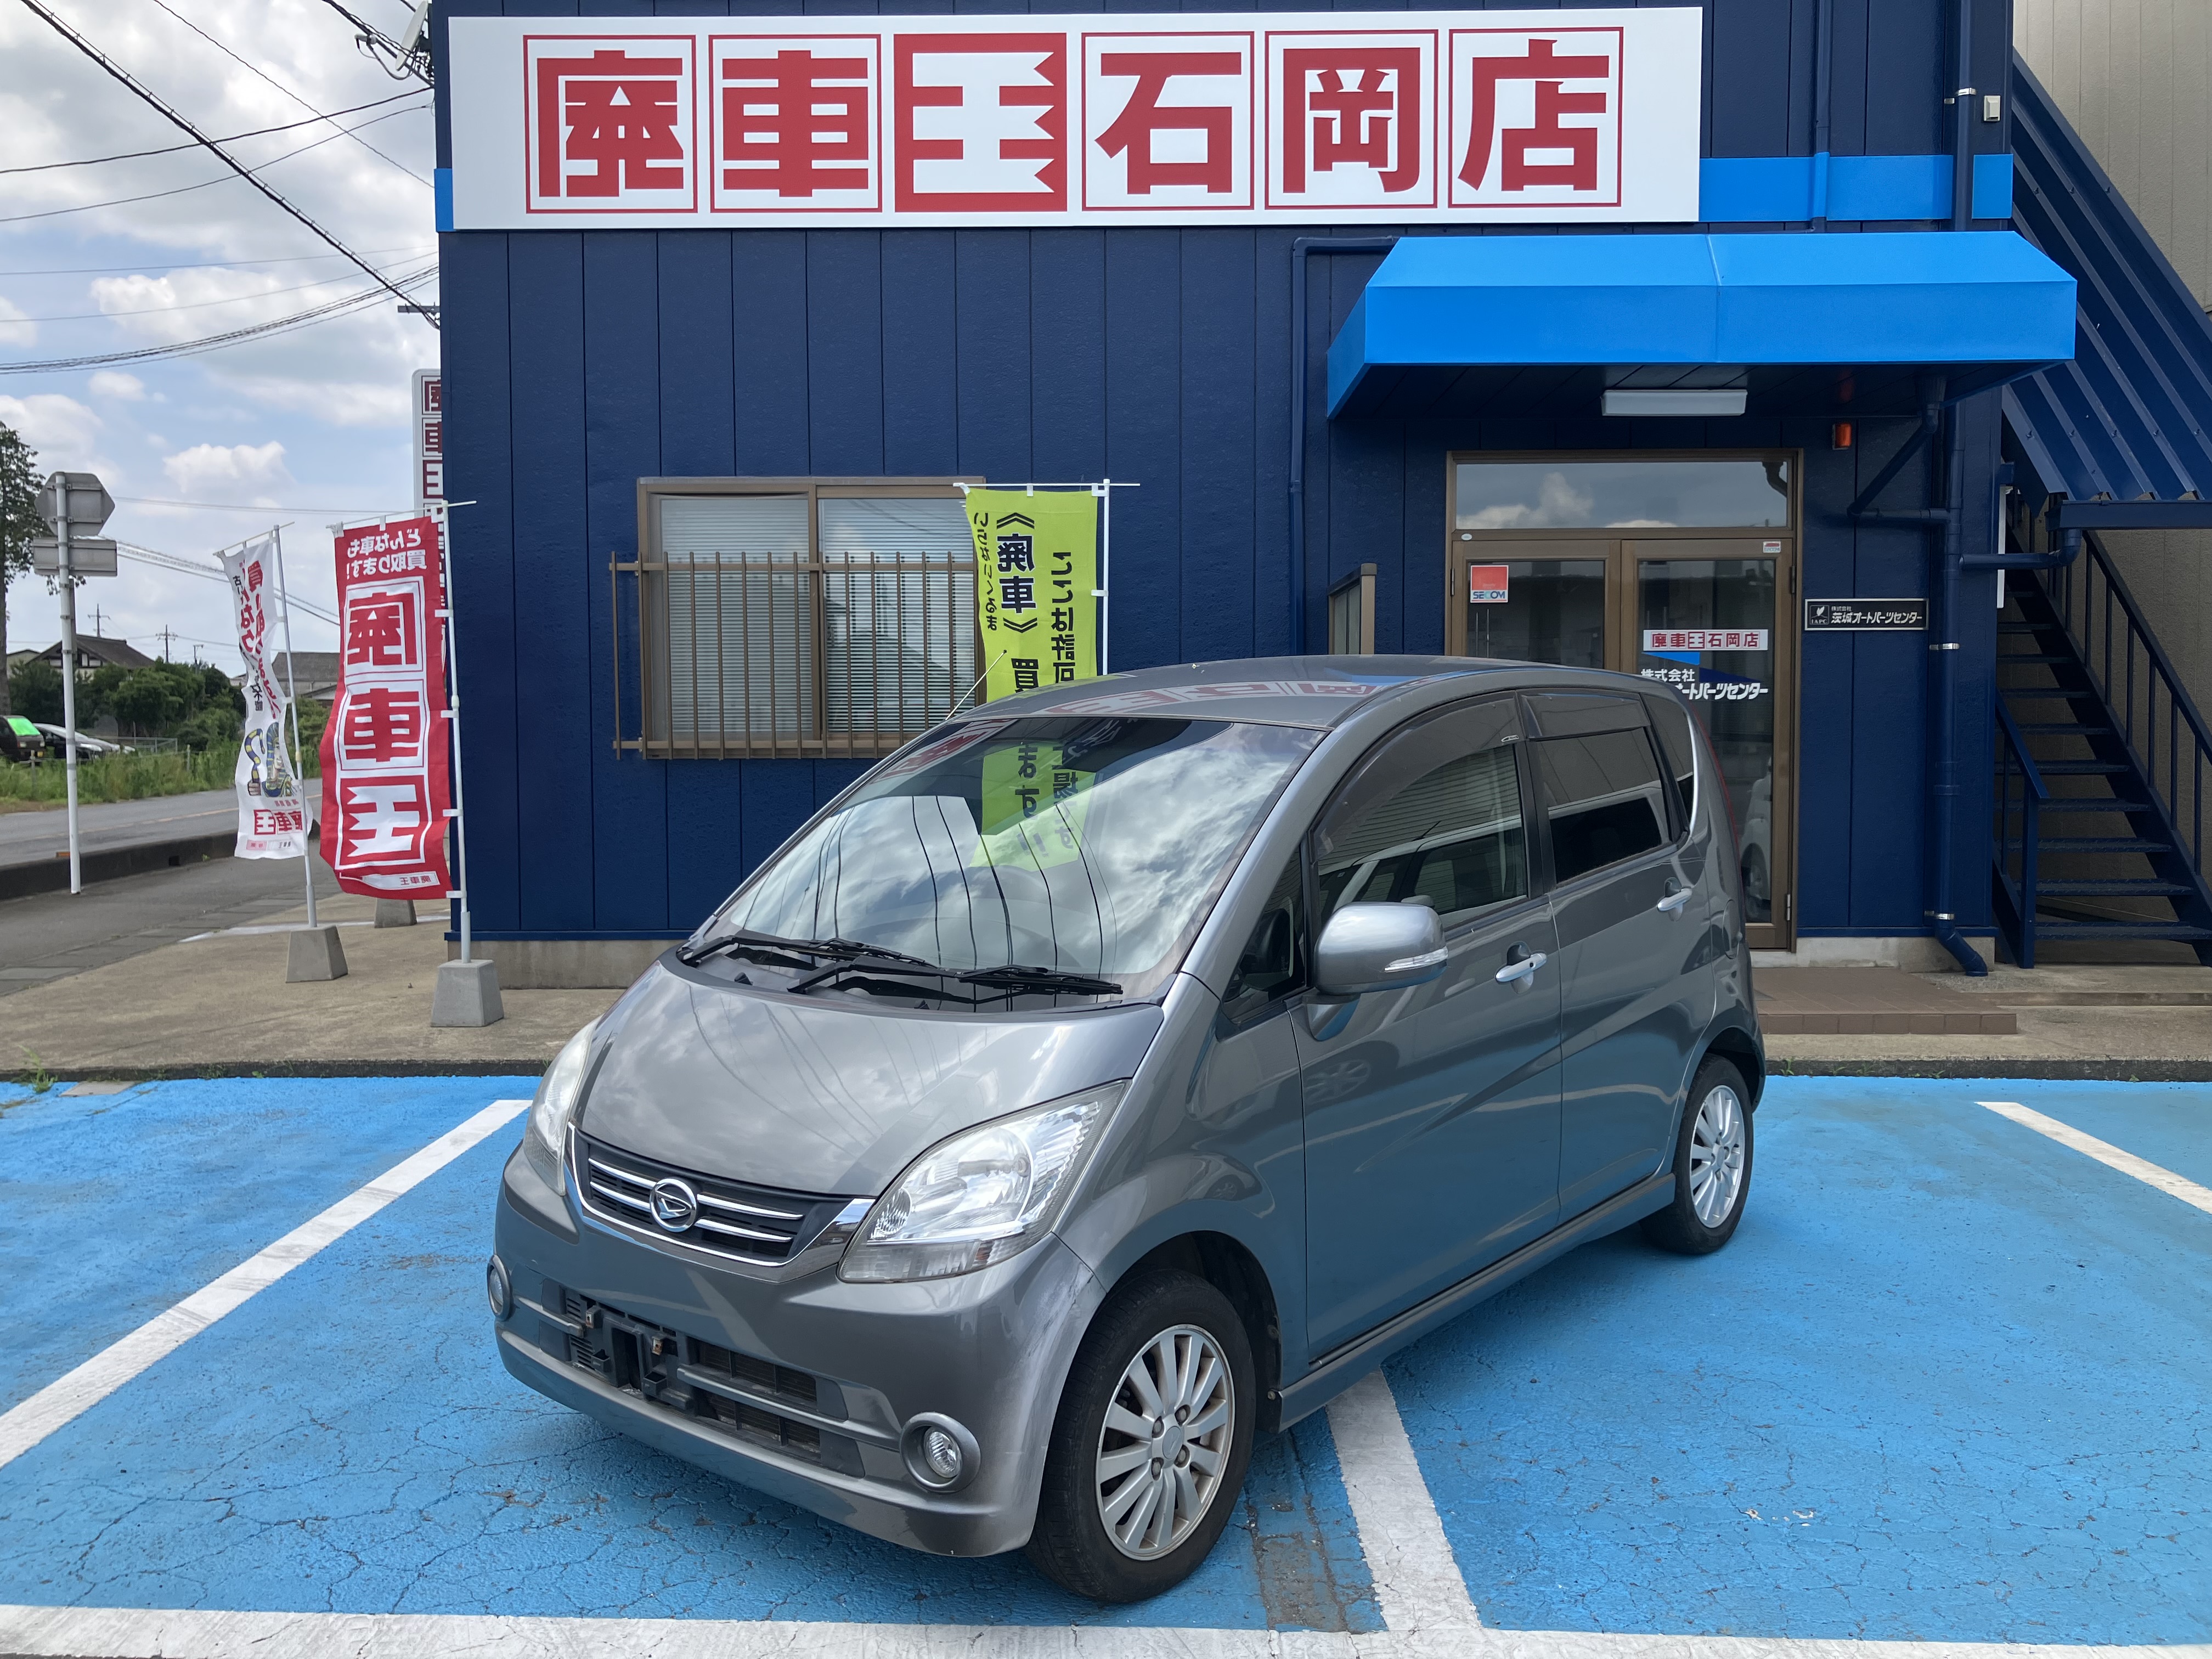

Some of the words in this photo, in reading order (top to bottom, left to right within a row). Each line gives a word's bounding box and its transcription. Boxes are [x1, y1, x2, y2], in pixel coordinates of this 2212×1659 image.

[536, 35, 1611, 211] 廃車王石岡店
[1472, 591, 1505, 599] SECOM
[1831, 611, 1922, 624] 茨城オートパーツセンター
[1652, 631, 1759, 649] 廃車王石岡店
